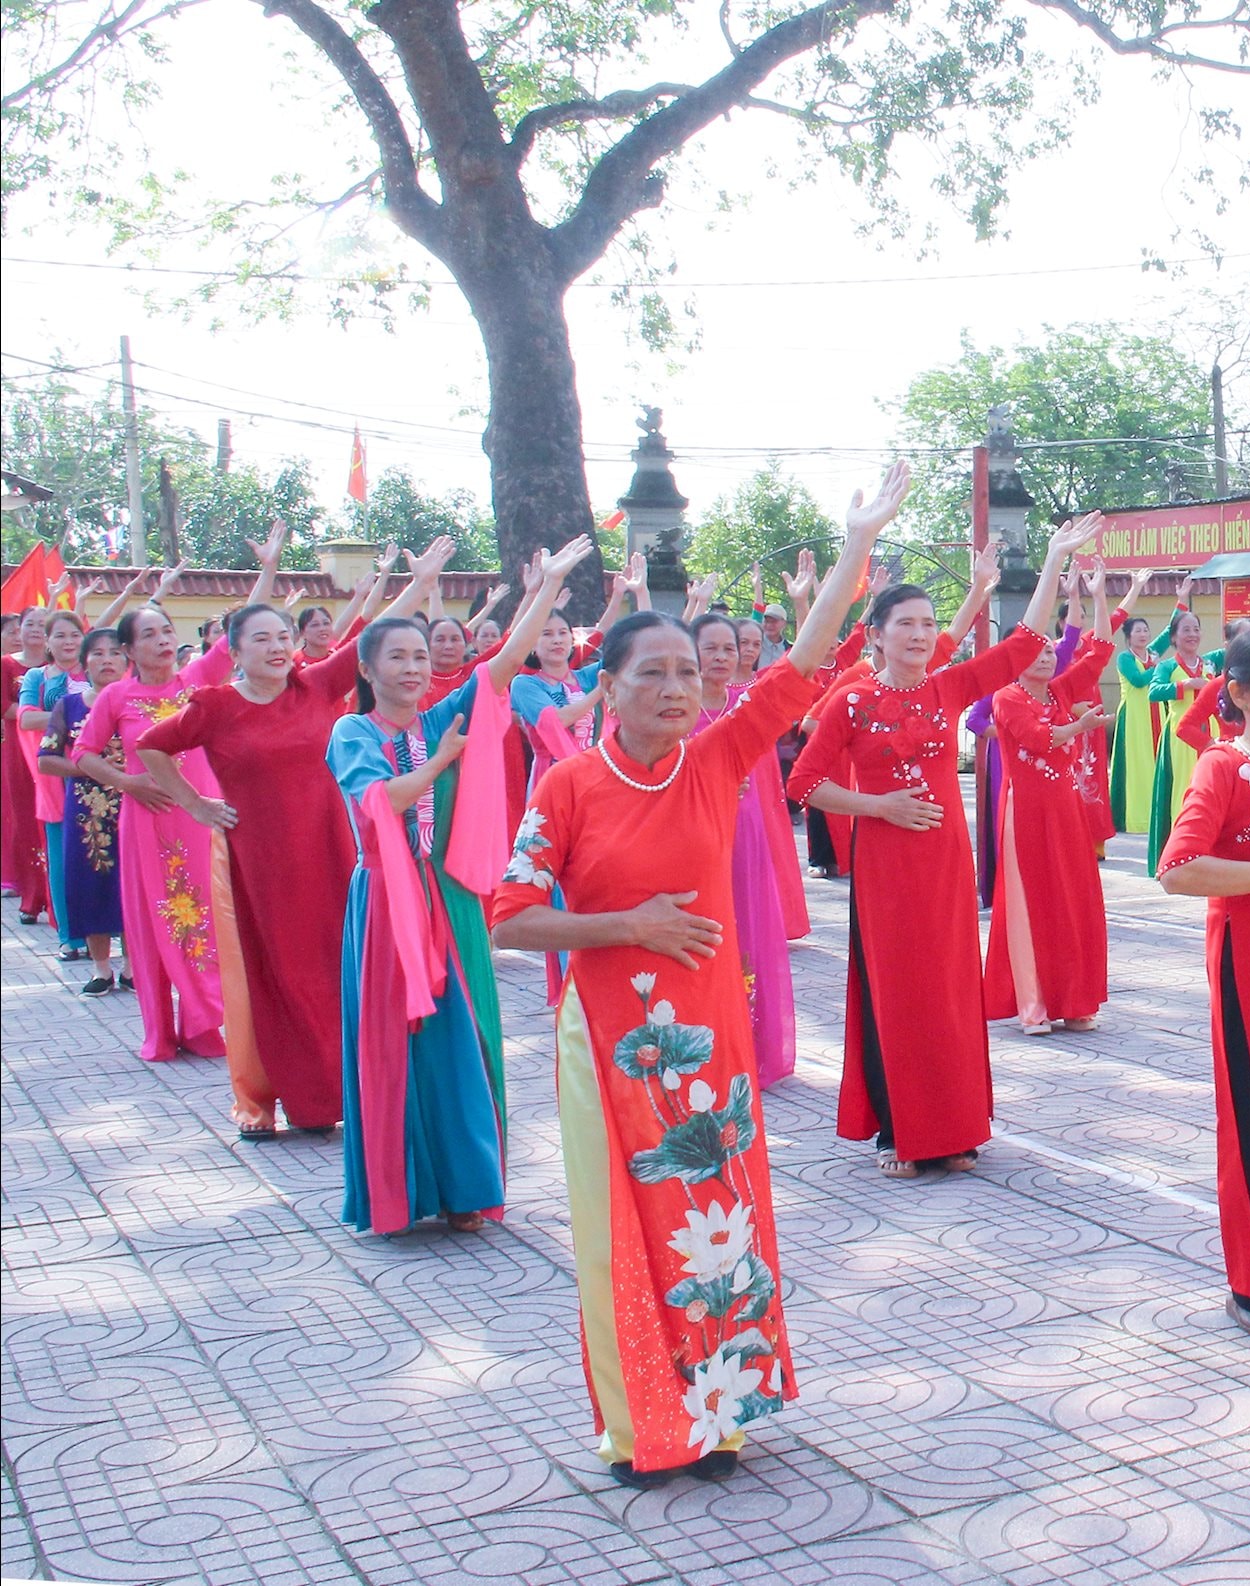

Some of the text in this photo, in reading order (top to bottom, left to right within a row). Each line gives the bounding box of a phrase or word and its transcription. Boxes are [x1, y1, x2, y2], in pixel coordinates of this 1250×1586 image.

[1102, 521, 1131, 558] SỐNG
[1134, 522, 1157, 557] LÀM
[1160, 520, 1186, 561] VIỆC
[1189, 522, 1219, 553] THEO
[1225, 510, 1250, 551] HIẾN
